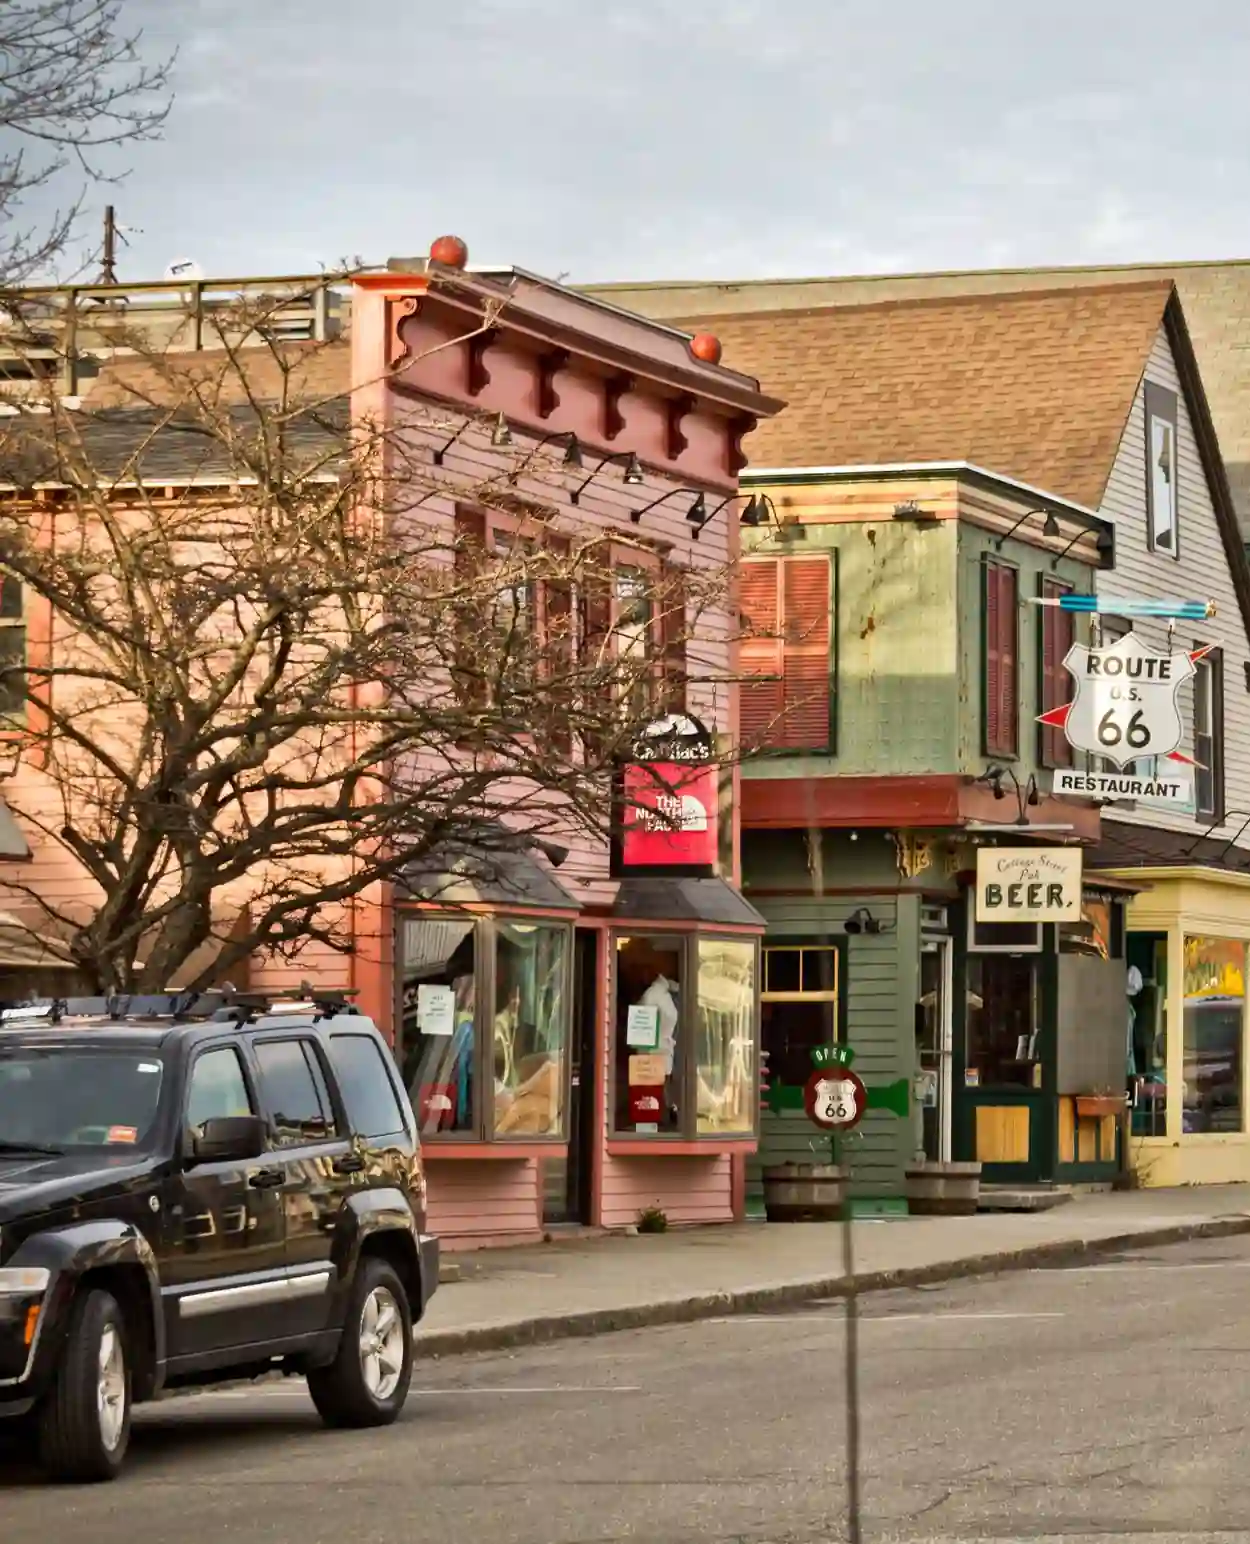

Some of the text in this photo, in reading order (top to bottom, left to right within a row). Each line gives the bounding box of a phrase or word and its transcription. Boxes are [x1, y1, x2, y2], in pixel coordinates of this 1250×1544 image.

[1087, 655, 1171, 680] ROUTE
[1109, 687, 1142, 702] U.S.
[1098, 708, 1151, 749] 66
[1062, 775, 1181, 798] RESTAURANT
[655, 795, 681, 808] THE
[645, 819, 681, 832] FAC
[815, 1047, 847, 1063] OPEN
[825, 1103, 847, 1118] 66
